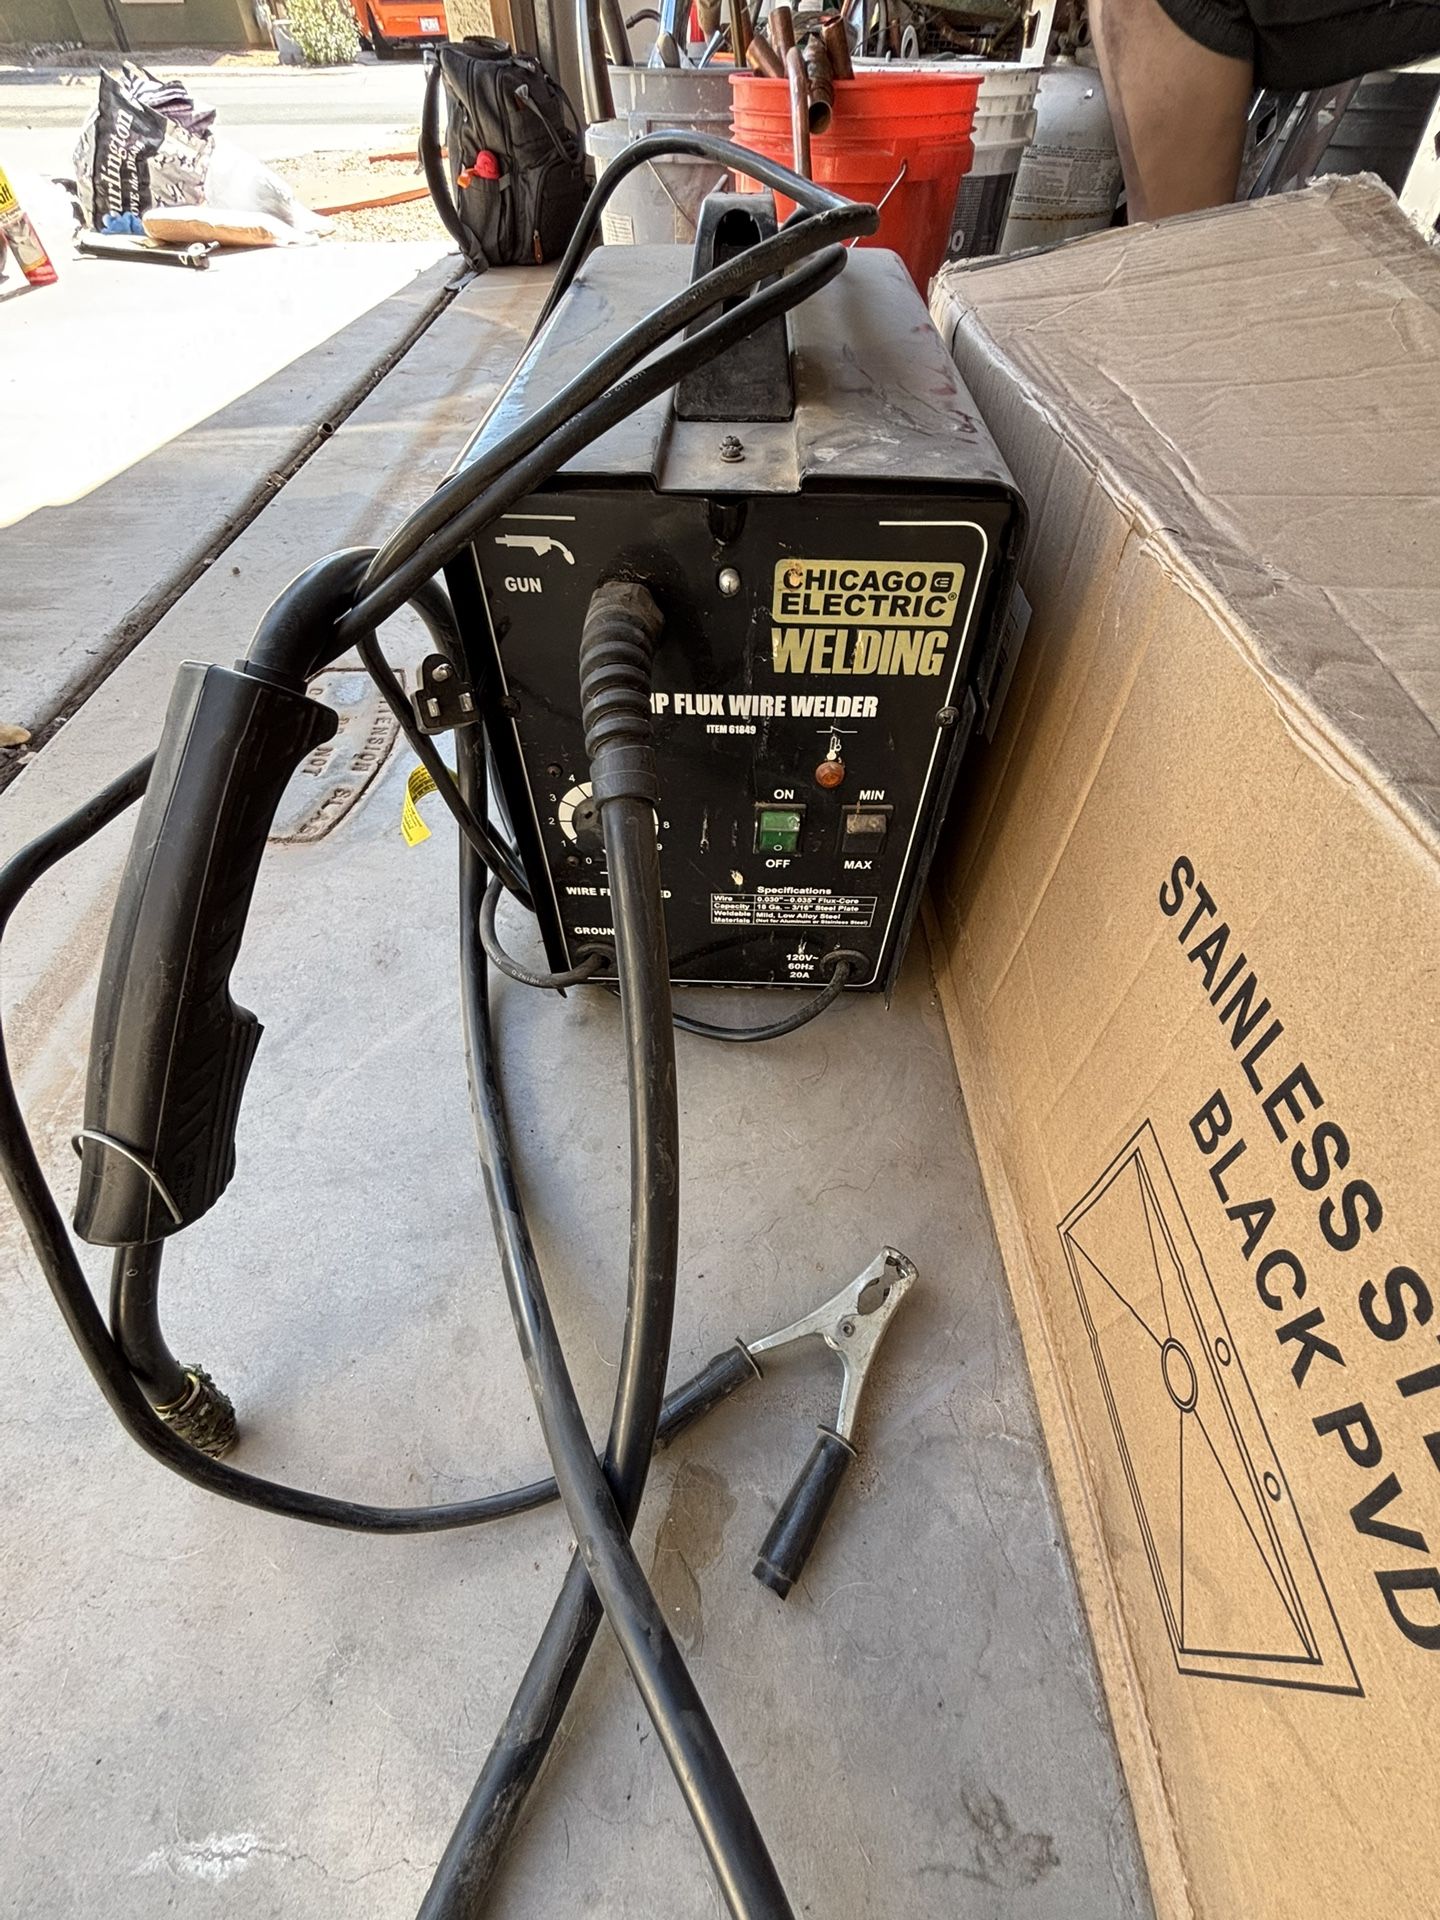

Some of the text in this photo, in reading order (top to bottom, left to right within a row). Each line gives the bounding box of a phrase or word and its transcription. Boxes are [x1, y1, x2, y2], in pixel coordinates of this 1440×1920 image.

[101, 108, 134, 213] urlington
[128, 191, 141, 217] OVE
[504, 576, 542, 593] GUN
[783, 568, 927, 592] CHICAGO
[780, 593, 947, 618] ELECTRIC
[771, 627, 949, 676] WELDING
[673, 693, 725, 716] FLUX
[728, 695, 787, 717] WIRE
[791, 696, 879, 718] WELDER
[706, 724, 757, 735] ITEM 61849
[568, 774, 576, 782] 4
[549, 793, 557, 802] 3
[773, 789, 795, 800] ON
[858, 789, 885, 800] MIN
[548, 817, 556, 825] 2
[662, 821, 670, 829] 8
[561, 840, 567, 848] 1
[585, 857, 593, 865] 0
[765, 859, 791, 869] OFF
[843, 860, 873, 870] MAX
[565, 886, 598, 896] WIRE
[756, 886, 832, 895] Specifications
[713, 902, 750, 910] Capacity
[574, 926, 617, 936] GROUN
[787, 963, 815, 971] 60Hz
[789, 971, 811, 979] 20A
[1159, 855, 1383, 1252] STAINLESS
[1189, 1088, 1347, 1389] BLACK
[1312, 1402, 1440, 1652] PVD
